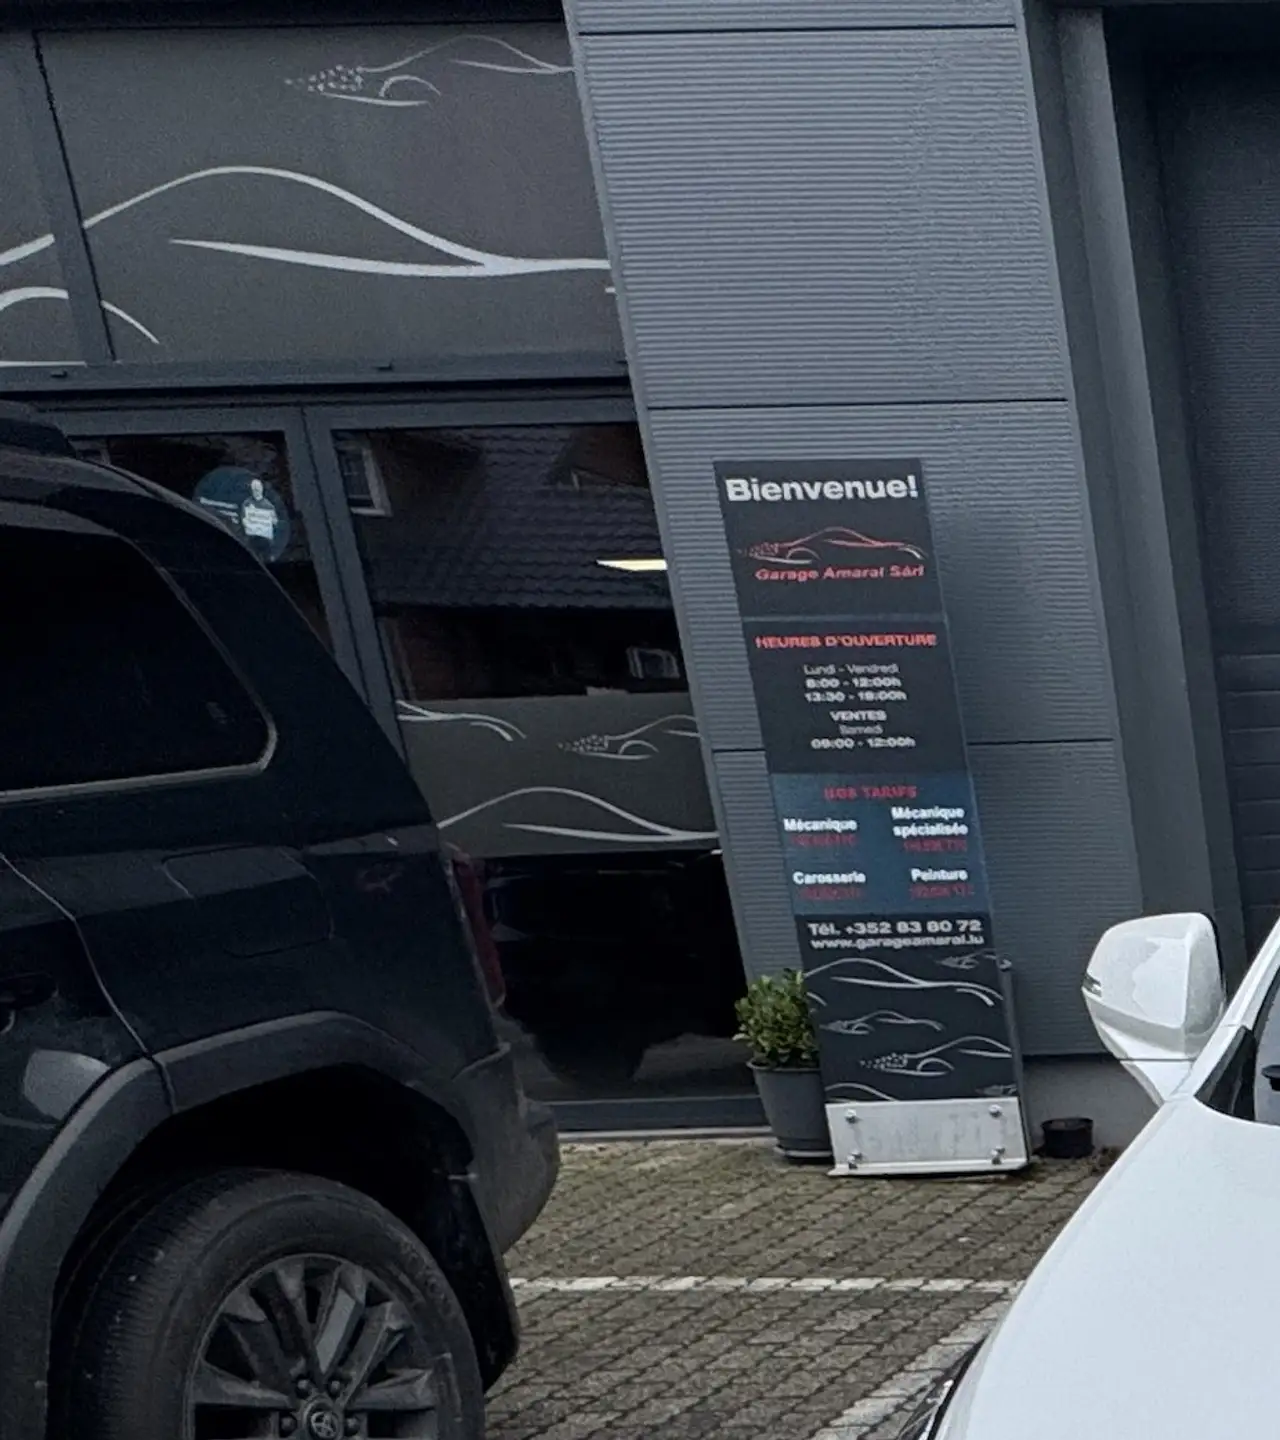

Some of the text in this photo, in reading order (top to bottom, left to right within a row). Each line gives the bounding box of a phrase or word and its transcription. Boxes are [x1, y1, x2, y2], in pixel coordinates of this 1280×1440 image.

[725, 475, 918, 501] Bienvenue!
[755, 567, 819, 582] Garage
[823, 567, 884, 579] Amaral
[755, 633, 937, 649] HEURES D'OUVERTURE
[803, 663, 836, 675] Lundi
[845, 662, 900, 675] Vendredi
[829, 710, 888, 721] VENTES
[861, 786, 918, 798] TARIFS
[890, 806, 965, 820] Mécanique
[783, 818, 858, 833] Mécanique
[893, 822, 969, 838] spécialisée
[910, 868, 969, 882] Peinture
[808, 919, 982, 936] Tél. +352 83 80 72
[810, 934, 985, 950] www.garageamaral.lu
